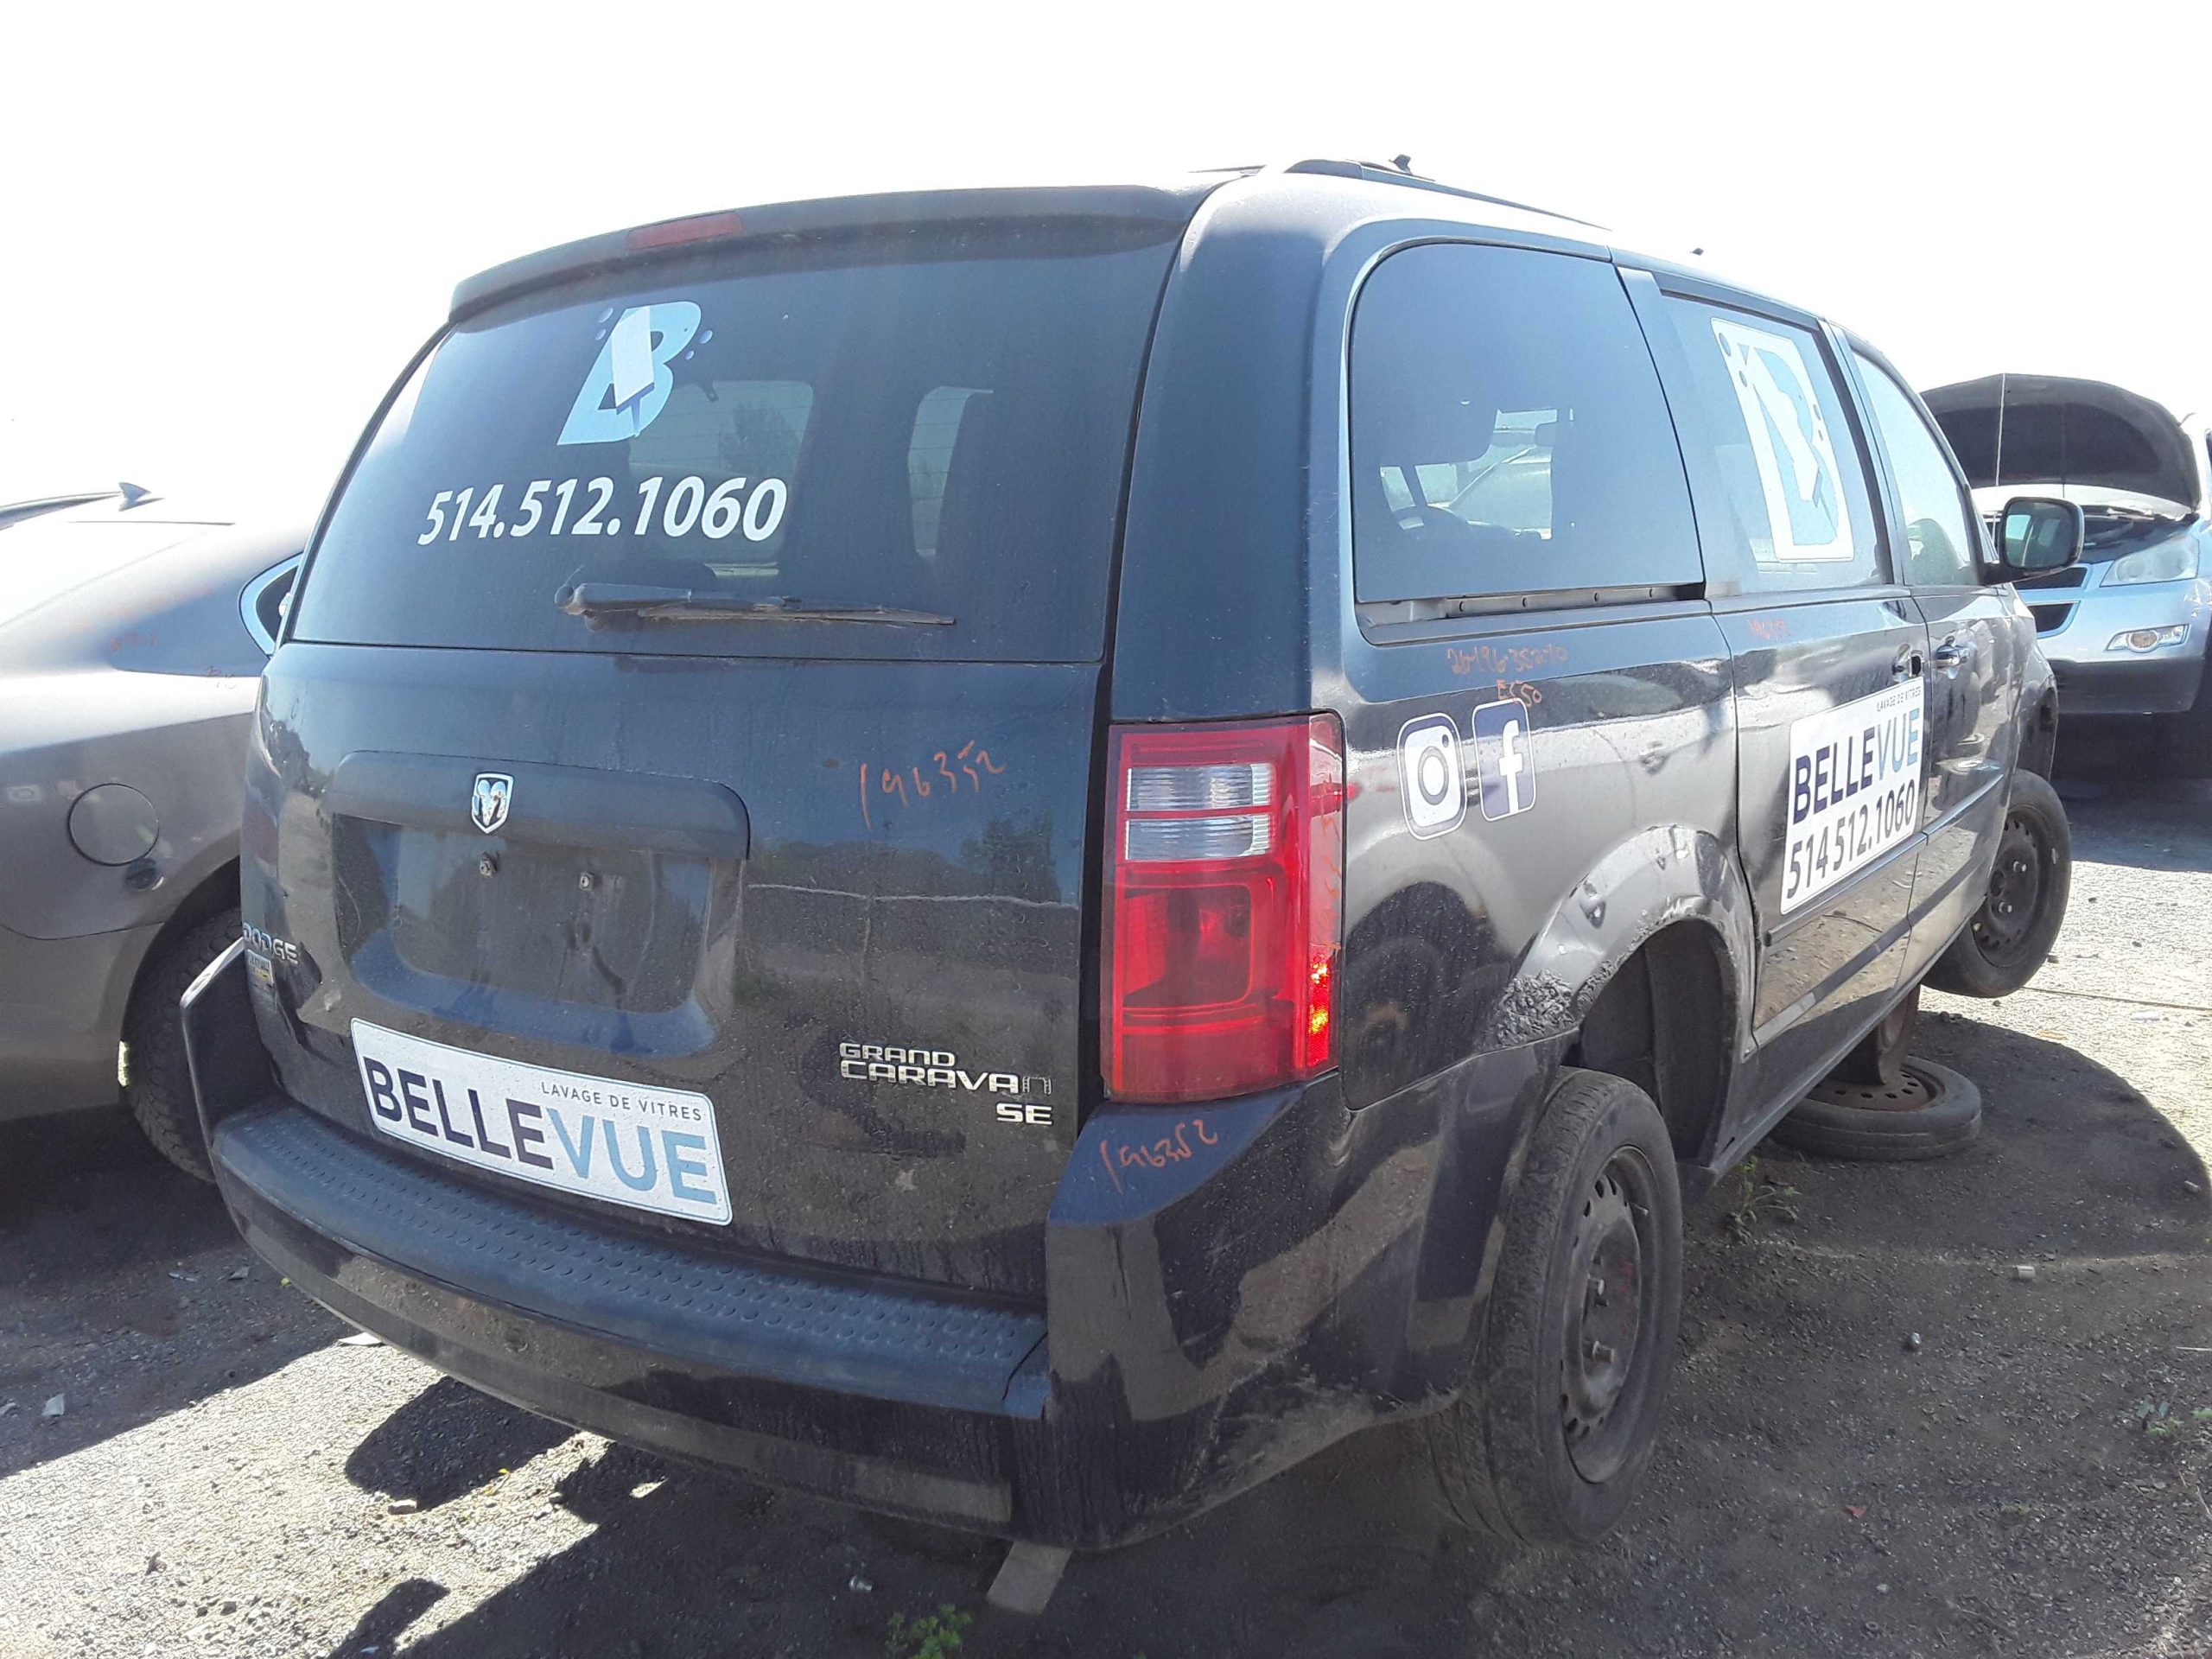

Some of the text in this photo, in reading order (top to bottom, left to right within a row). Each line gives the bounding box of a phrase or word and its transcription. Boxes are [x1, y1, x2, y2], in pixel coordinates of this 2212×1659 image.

[557, 301, 702, 446] B
[416, 475, 788, 545] 514.512.1060
[1793, 708, 1920, 825] BELLEVUE
[839, 1042, 956, 1067] GRAND
[840, 1059, 1052, 1096] CARAVAN
[541, 1081, 702, 1122] LAVAGE DE VITRES
[995, 1103, 1052, 1125] SE
[363, 1056, 717, 1205] BELLEVUE
